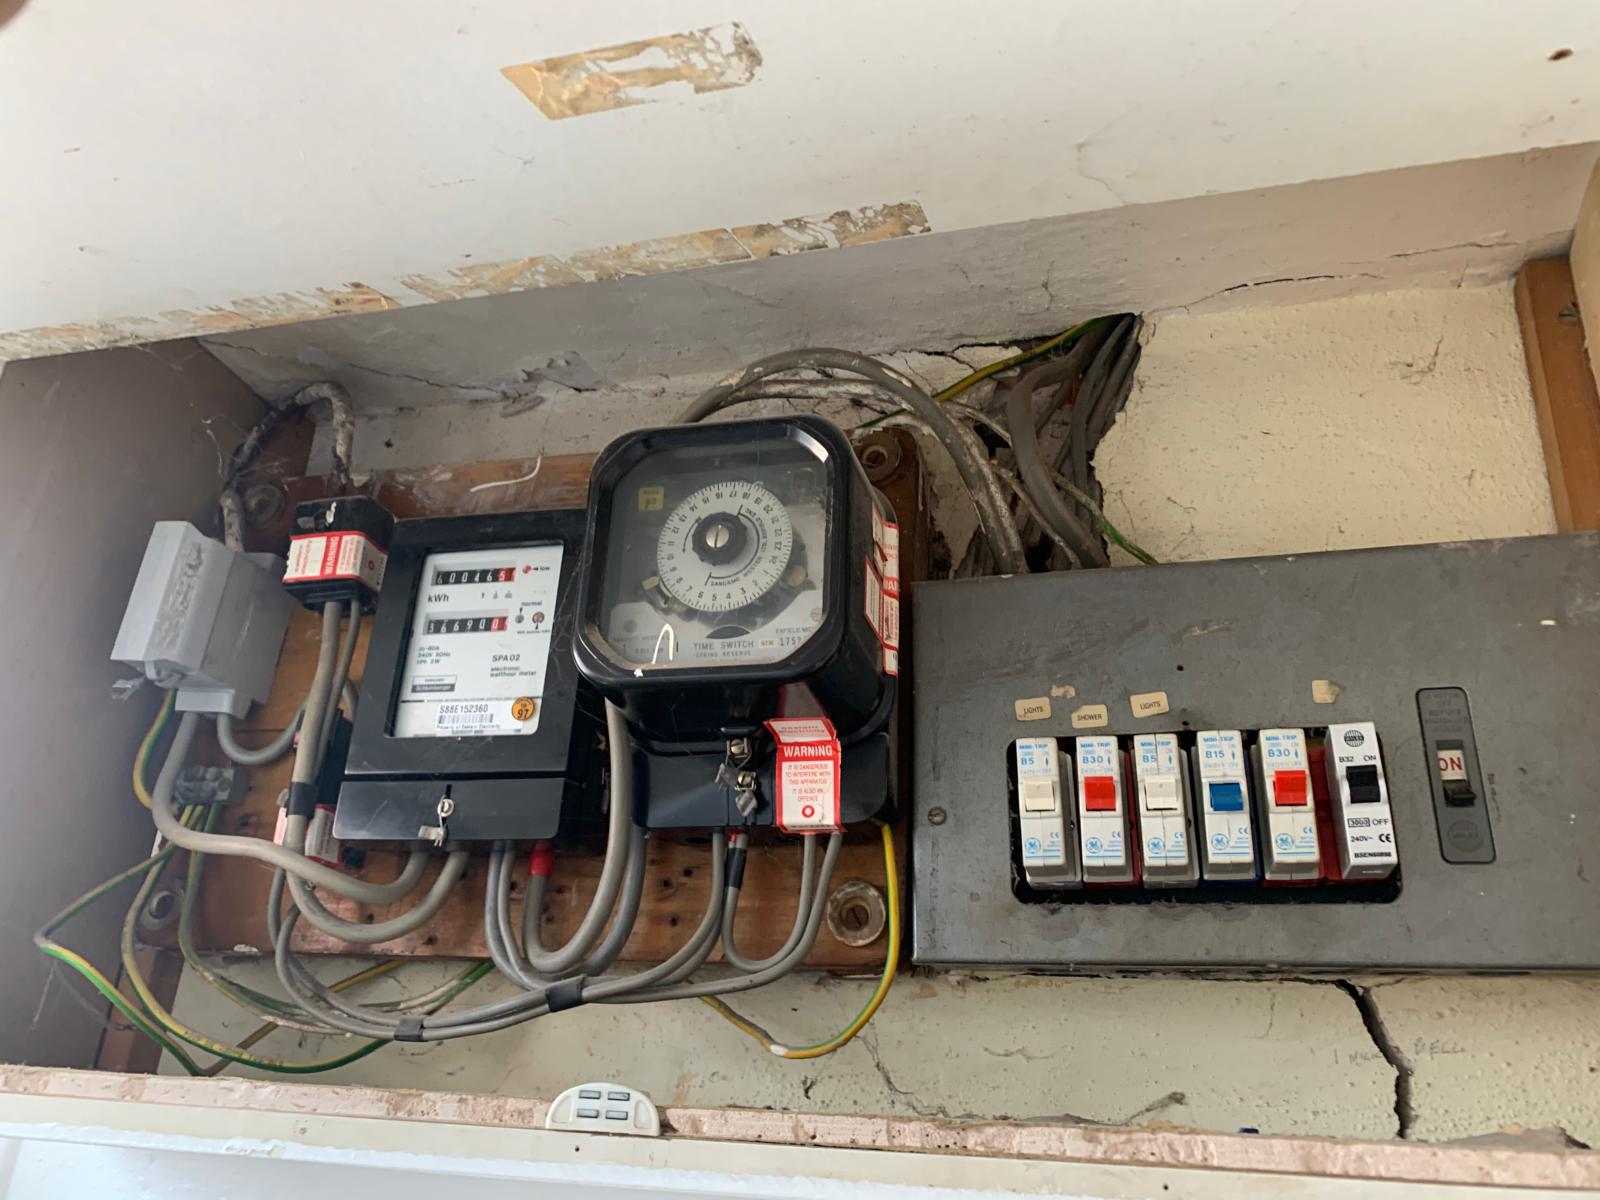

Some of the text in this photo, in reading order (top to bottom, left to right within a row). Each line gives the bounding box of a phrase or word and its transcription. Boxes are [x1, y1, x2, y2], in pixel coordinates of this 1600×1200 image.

[427, 592, 449, 603] kWh
[693, 642, 714, 650] TIME
[720, 640, 754, 649] SWITCH
[1023, 706, 1044, 714] LIGHTS
[1140, 701, 1161, 710] LIGHTS
[1077, 713, 1102, 721] SHOWER
[783, 745, 833, 757] WARNING
[1205, 750, 1225, 758] B15
[1268, 749, 1290, 757] B30
[1021, 757, 1035, 766] B5
[1082, 755, 1104, 764] B30
[1143, 754, 1157, 763] B5
[1439, 757, 1463, 771] ON
[1378, 833, 1391, 843] CE
